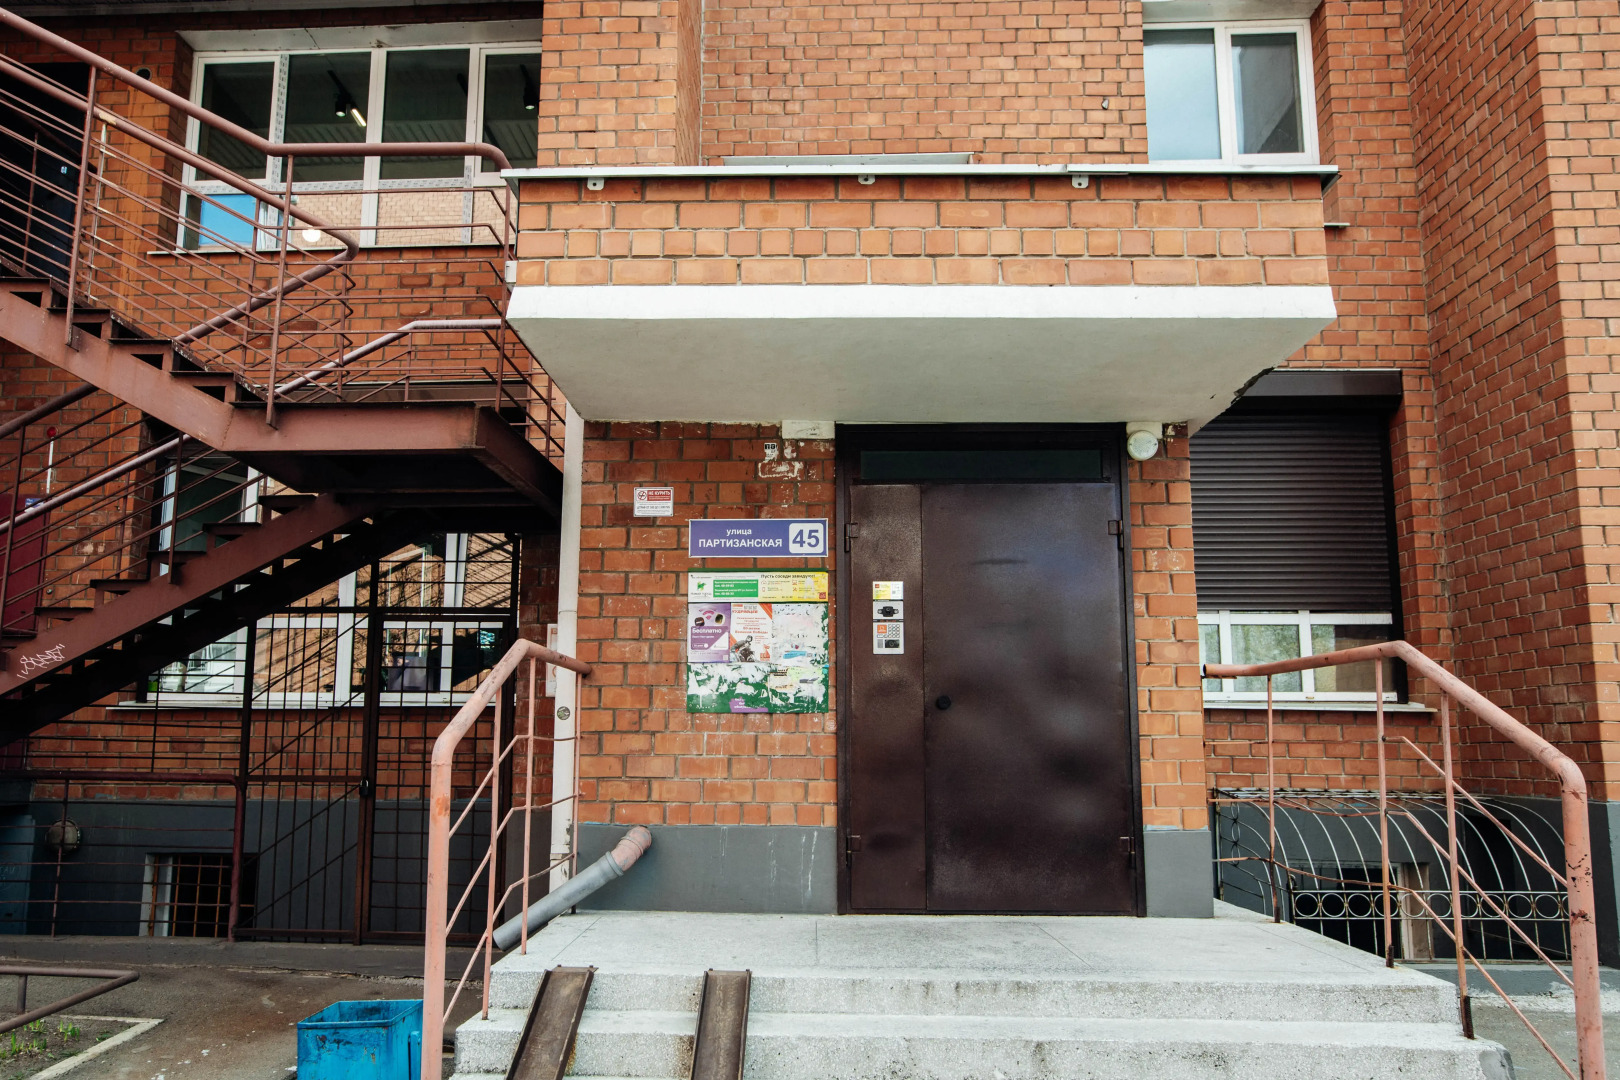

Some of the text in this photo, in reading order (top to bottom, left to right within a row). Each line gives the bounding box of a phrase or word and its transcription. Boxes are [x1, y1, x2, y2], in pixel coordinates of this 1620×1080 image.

[726, 529, 752, 537] улица
[792, 529, 820, 548] 45
[698, 539, 783, 548] ПАРТИЗАНСКАЯ
